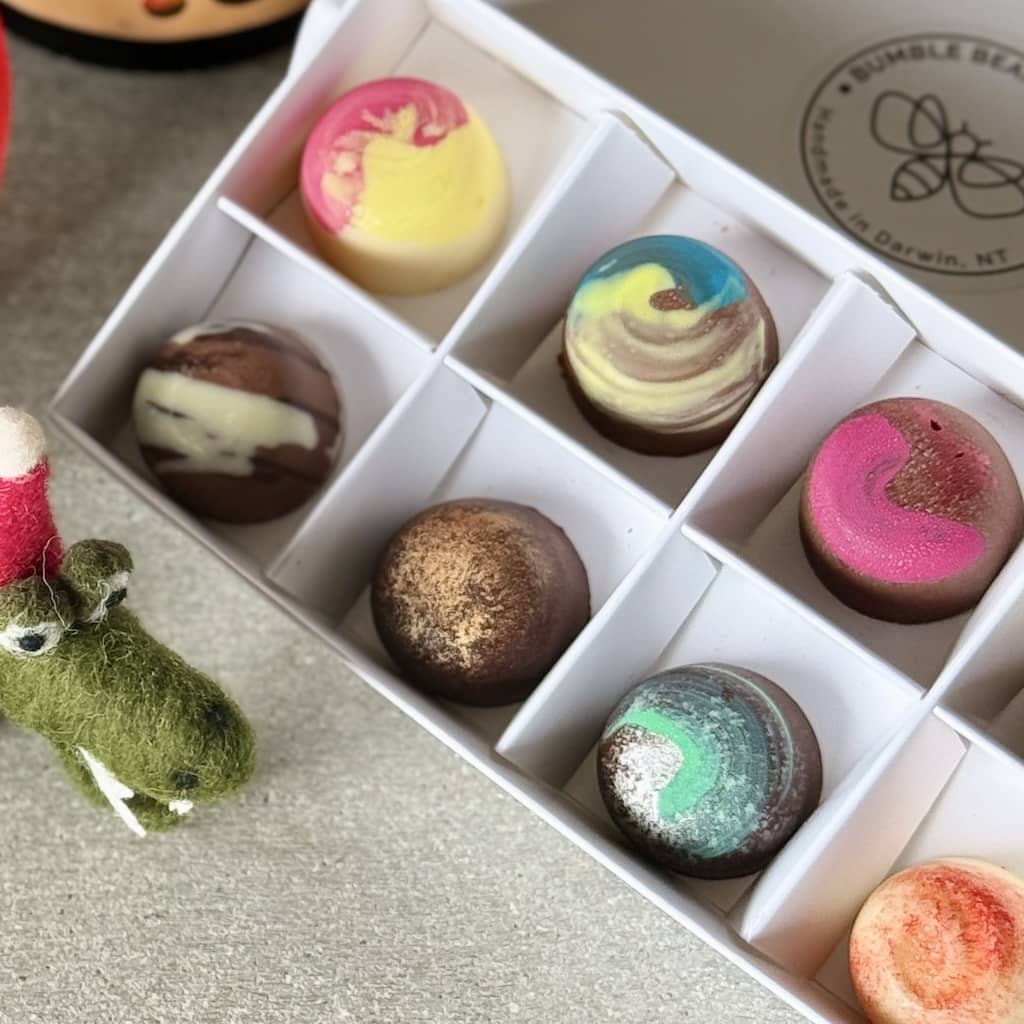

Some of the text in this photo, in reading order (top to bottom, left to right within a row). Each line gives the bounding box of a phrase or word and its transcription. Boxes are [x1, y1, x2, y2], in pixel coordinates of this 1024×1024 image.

[849, 43, 961, 83] BUMBLE
[811, 108, 848, 210] Handmade
[849, 213, 870, 233] in
[977, 248, 1008, 266] NT
